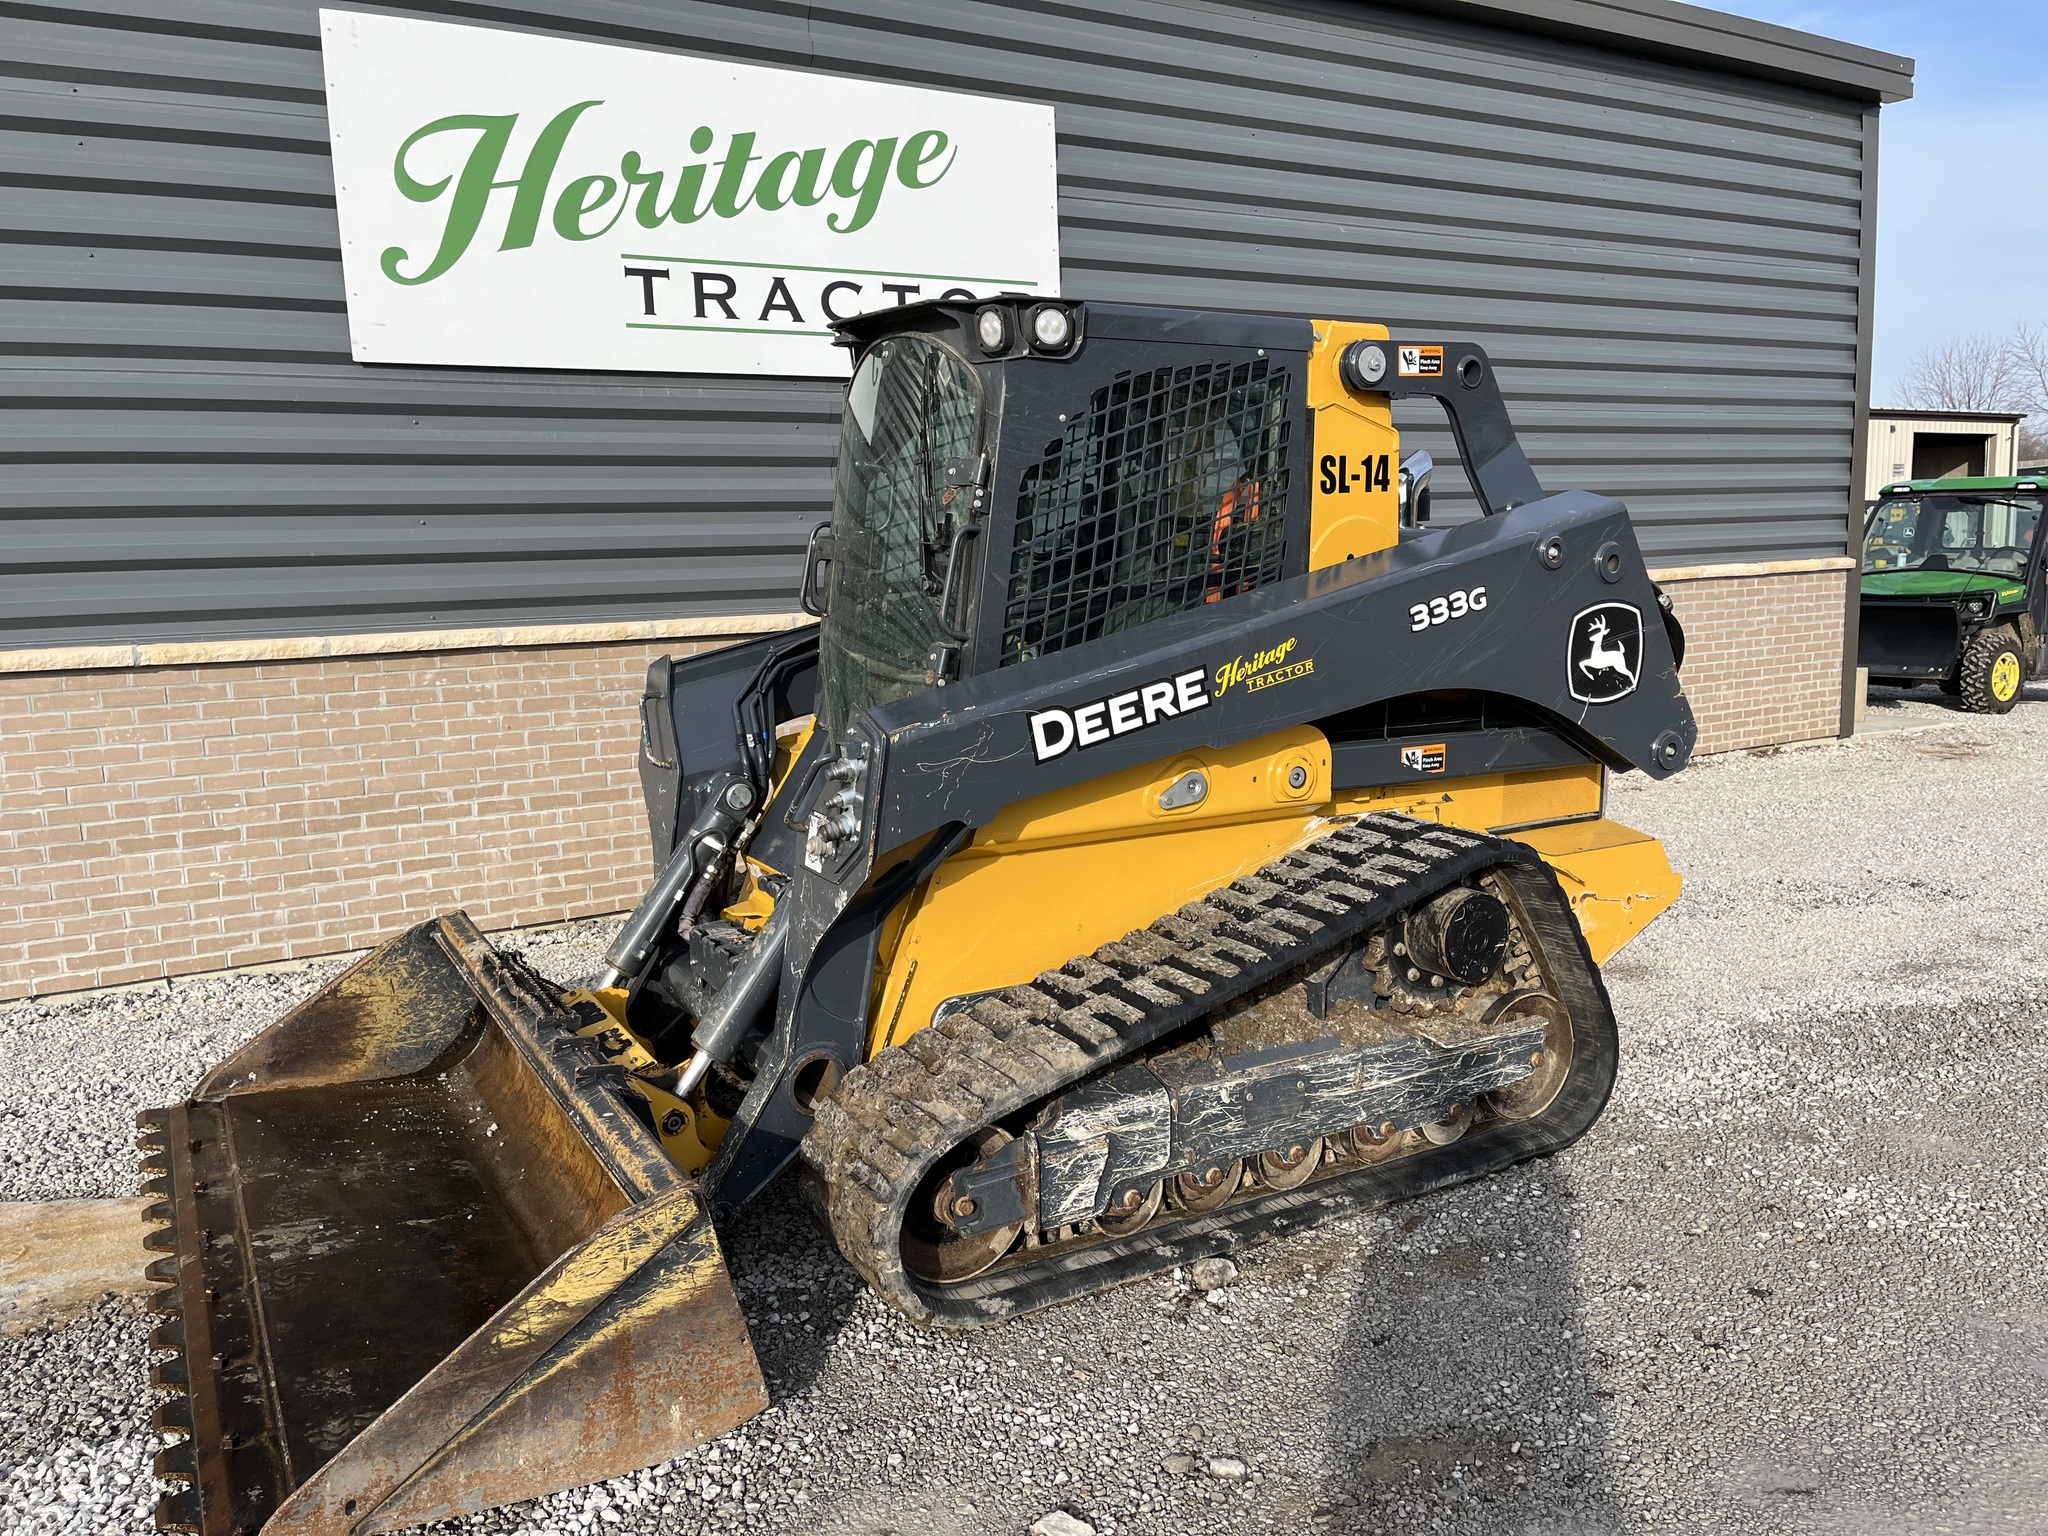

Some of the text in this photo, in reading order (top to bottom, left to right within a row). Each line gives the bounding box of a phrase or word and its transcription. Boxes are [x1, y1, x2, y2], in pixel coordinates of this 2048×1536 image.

[380, 100, 957, 286] Heritage
[624, 265, 1030, 323] TRACT
[1320, 454, 1390, 494] SL-14
[1409, 586, 1487, 632] 333G
[1214, 637, 1298, 698] Heritage
[1246, 661, 1314, 690] TRACTOR
[1030, 669, 1210, 761] DEERE
